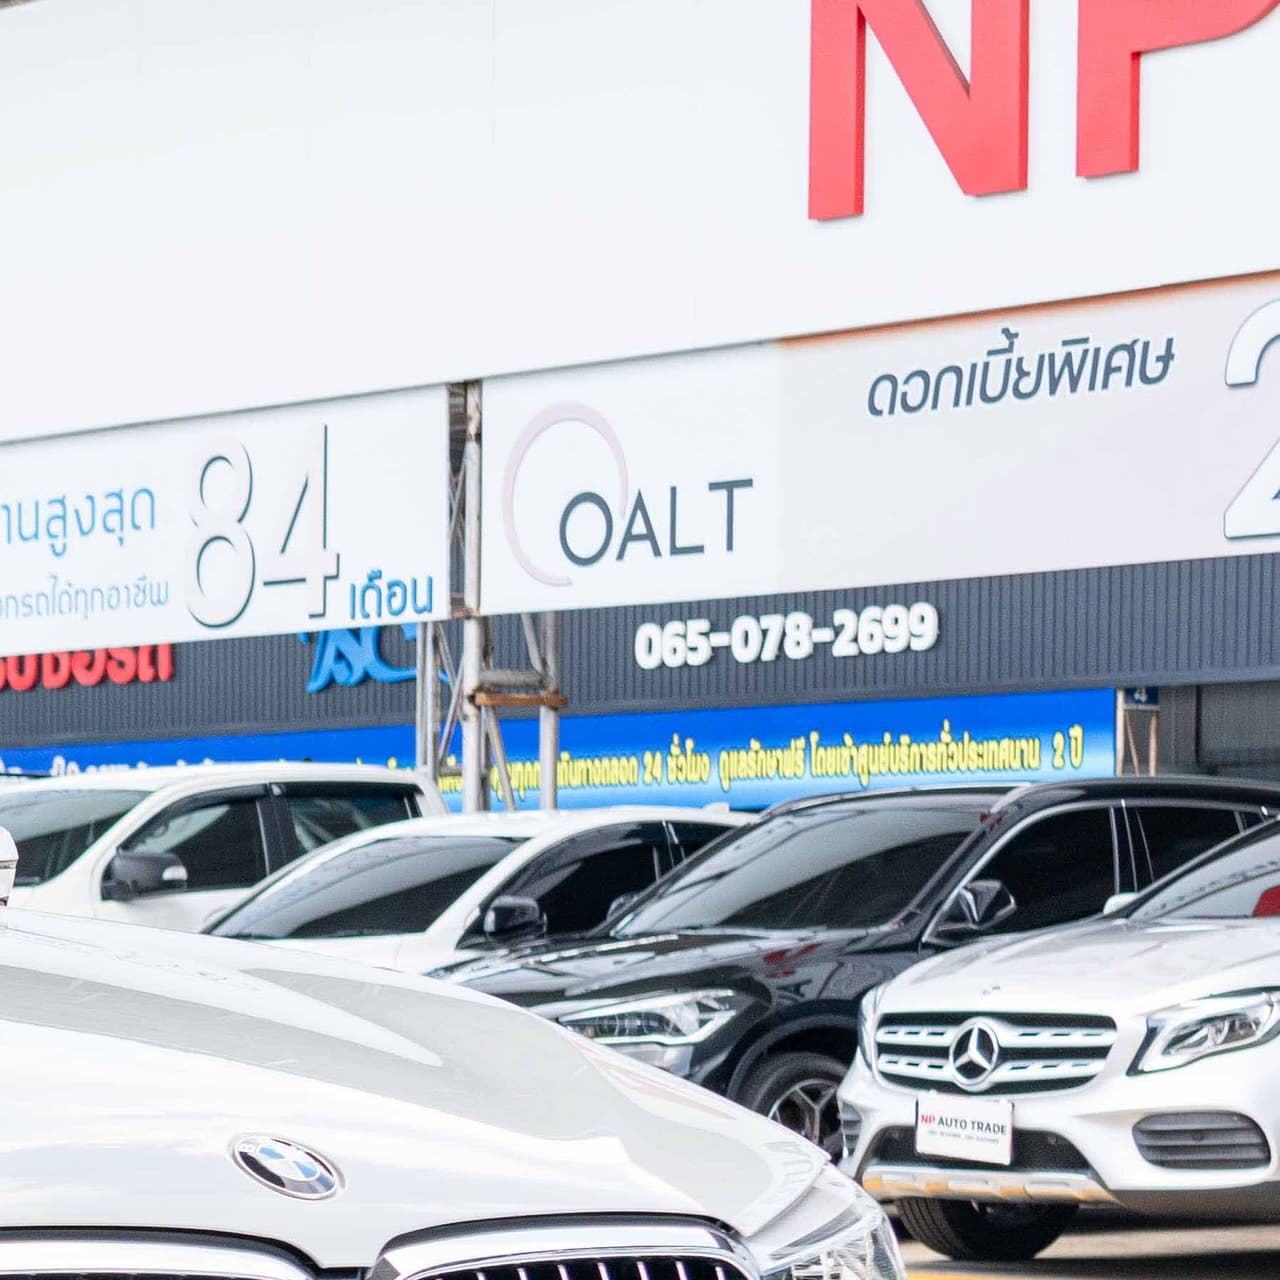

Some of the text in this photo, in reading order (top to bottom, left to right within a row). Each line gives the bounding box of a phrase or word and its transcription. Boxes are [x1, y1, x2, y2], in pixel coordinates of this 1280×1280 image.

[867, 326, 1176, 418] ดอกเบี้ยพิเศษ
[182, 424, 340, 629] 84
[349, 568, 434, 621] เดือน
[634, 601, 940, 670] 065-078-2699
[938, 1116, 968, 1130] AUTO
[970, 1120, 1007, 1136] TRADE
